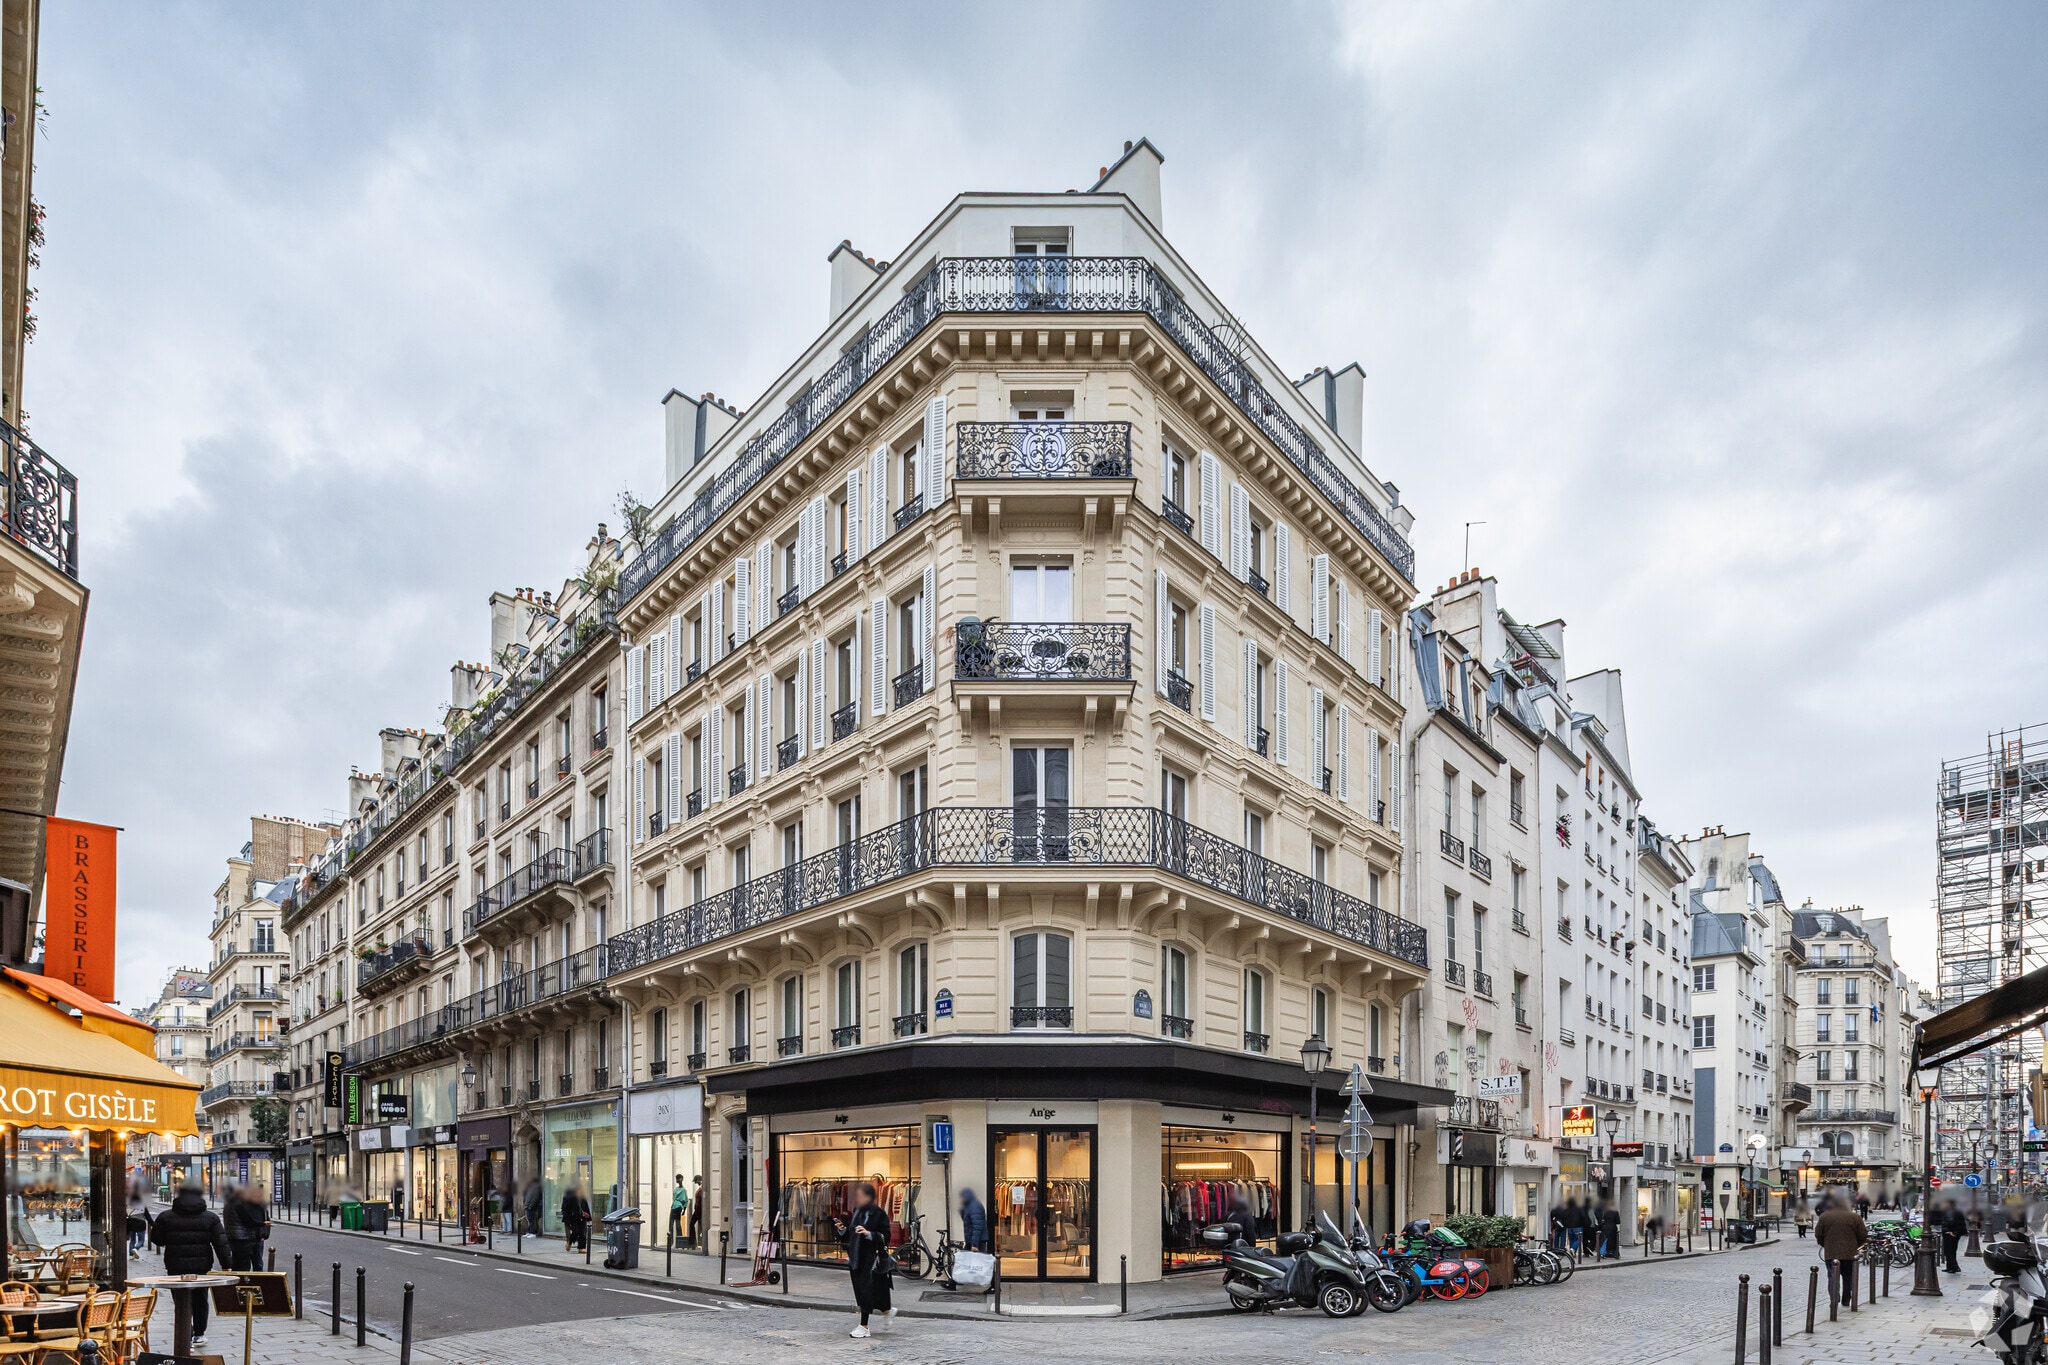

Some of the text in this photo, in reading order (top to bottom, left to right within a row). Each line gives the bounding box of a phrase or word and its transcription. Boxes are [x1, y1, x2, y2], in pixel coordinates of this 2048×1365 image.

[73, 835, 89, 987] BRASSERIE
[1480, 1075, 1518, 1090] S.T.F
[1479, 1088, 1520, 1096] ACCESSORIES
[64, 1089, 157, 1124] GISÈLE
[348, 1104, 356, 1124] TALIA
[1562, 1118, 1594, 1128] SUNNY
[1564, 1127, 1592, 1137] NAILS
